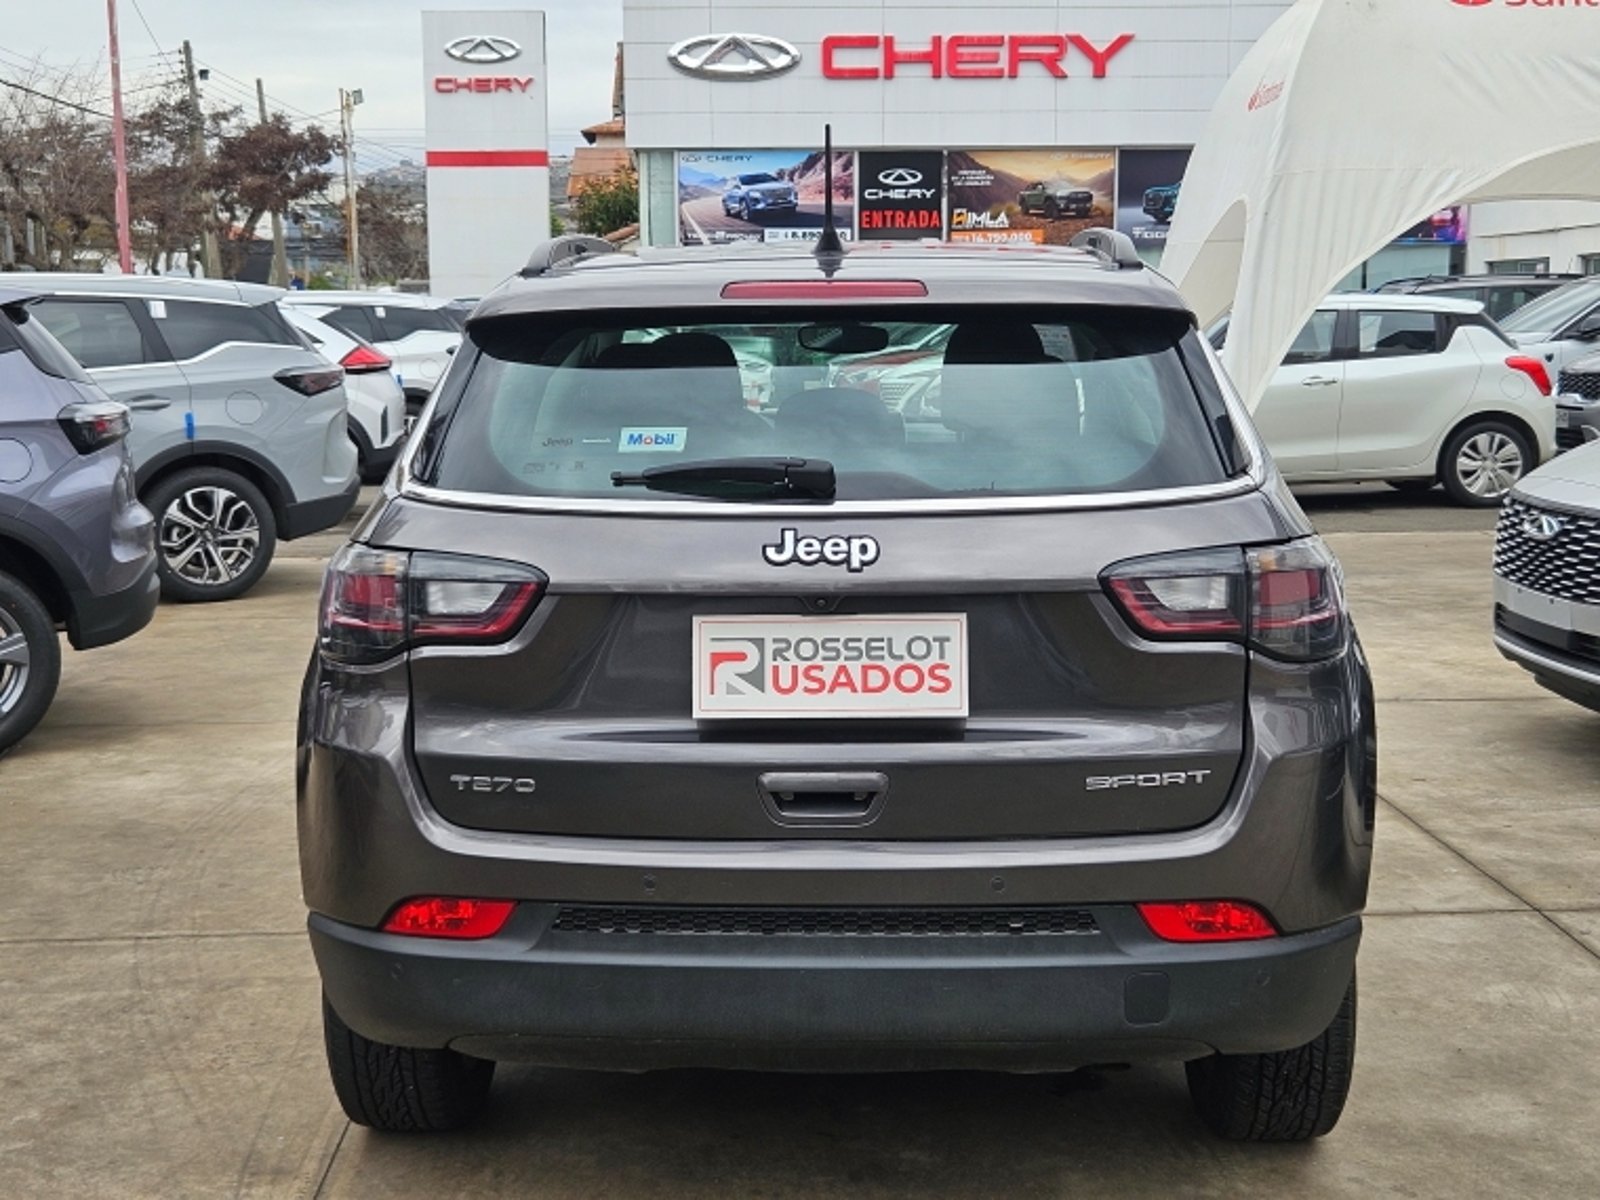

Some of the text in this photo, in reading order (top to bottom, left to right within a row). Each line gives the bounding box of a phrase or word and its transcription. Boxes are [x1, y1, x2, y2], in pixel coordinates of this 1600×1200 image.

[821, 34, 1136, 80] CHERY
[434, 77, 534, 94] CHERY
[864, 188, 936, 199] CHERY
[861, 210, 940, 228] ENTRADA
[627, 433, 675, 445] Mobil
[763, 528, 880, 571] Jeep
[772, 635, 951, 662] ROSSELOT
[771, 662, 953, 696] USADOS
[450, 774, 536, 793] T270
[1085, 769, 1212, 791] SPORT
